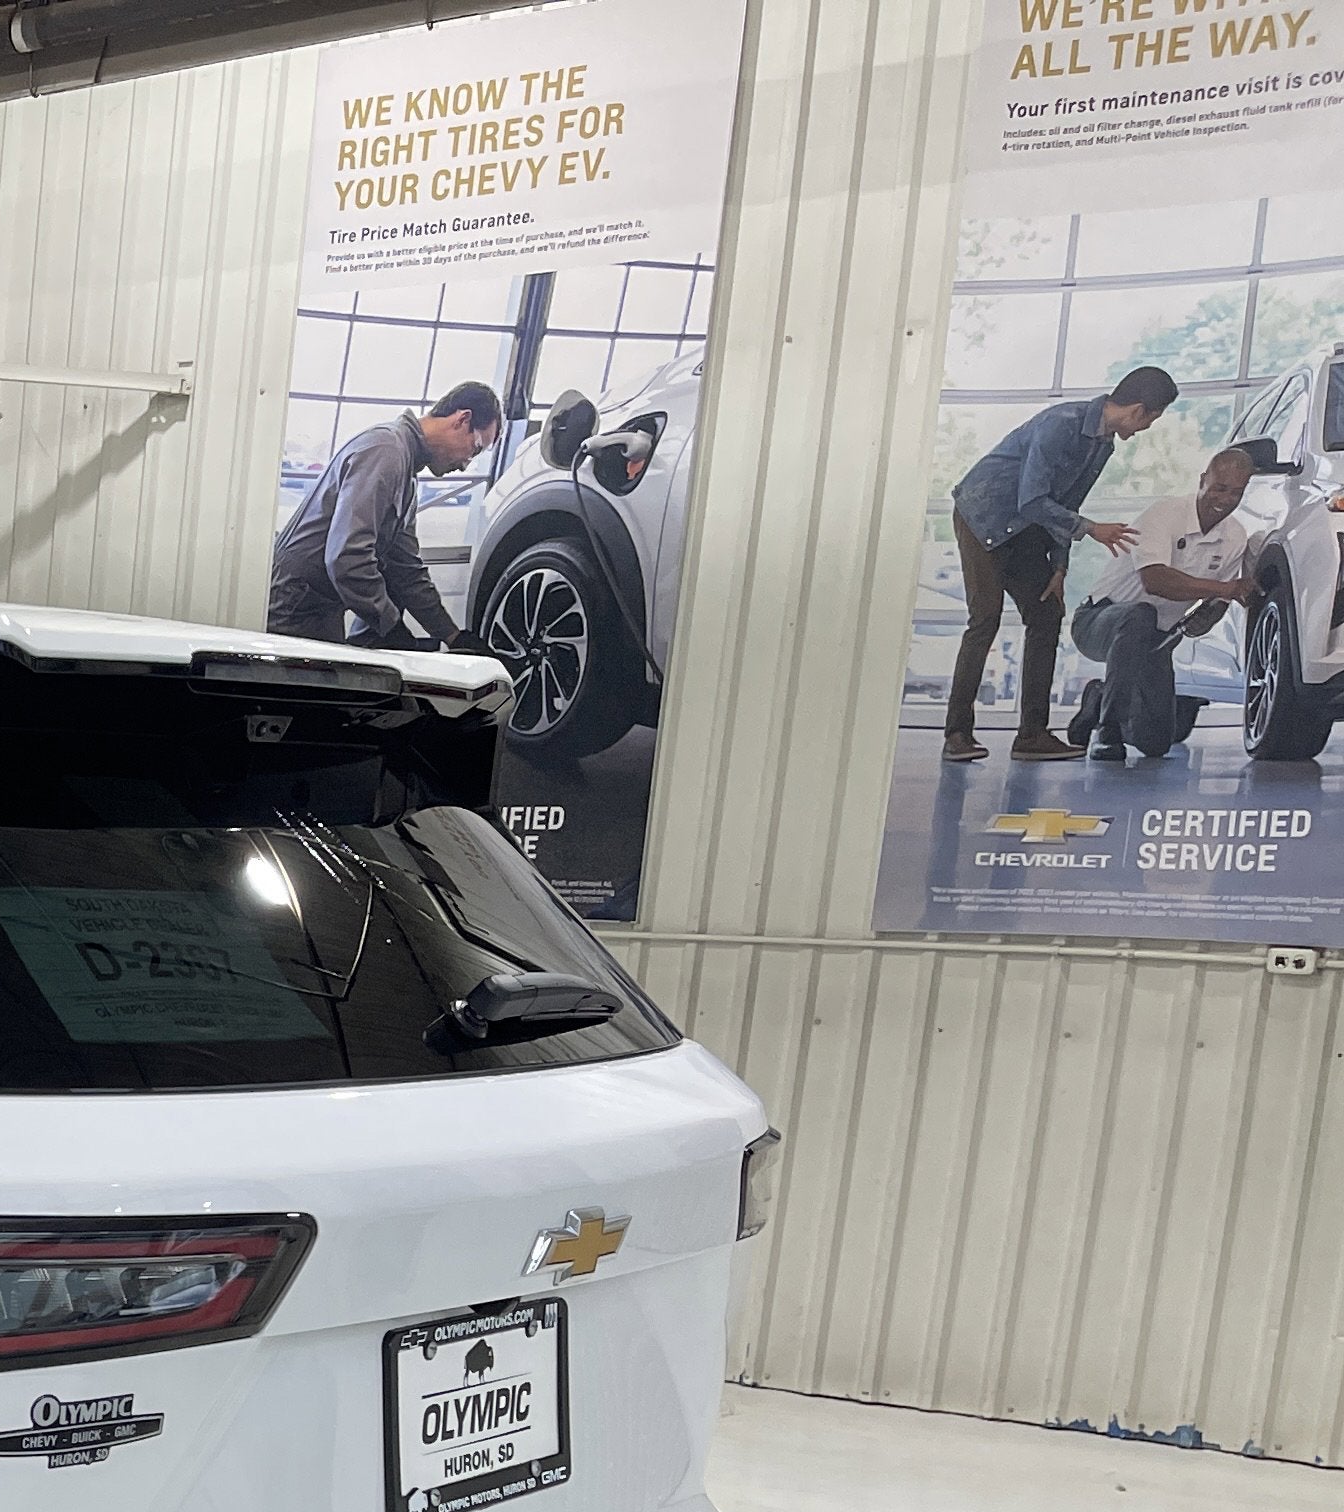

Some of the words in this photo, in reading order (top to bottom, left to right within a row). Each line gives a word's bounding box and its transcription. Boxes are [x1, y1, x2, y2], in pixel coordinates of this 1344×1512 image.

[1019, 0, 1153, 33] WERE
[1010, 39, 1091, 80] ALL
[1108, 25, 1194, 70] THE
[1210, 9, 1318, 58] WAY.
[343, 94, 395, 129] WE
[404, 77, 509, 122] KNOW
[520, 65, 587, 105] THE
[1007, 102, 1049, 119] Your
[1054, 96, 1096, 115] first
[1102, 84, 1230, 111] maintenance
[1236, 75, 1280, 96] visit
[1286, 72, 1302, 90] is
[1309, 69, 1344, 86] cov
[1003, 129, 1046, 139] Includes:
[1049, 126, 1060, 136] oil
[1063, 125, 1080, 134] and
[1083, 123, 1095, 133] oil
[1097, 120, 1122, 132] filter
[1124, 118, 1164, 130] change,
[1166, 113, 1197, 125] diesel
[1199, 109, 1240, 122] exhaust
[1242, 105, 1266, 116] fluid
[1269, 103, 1293, 114] tank
[1295, 98, 1321, 111] refill
[338, 130, 437, 171] RIGHT
[448, 114, 545, 157] TIRES
[556, 103, 624, 143] FOR
[1002, 142, 1029, 152] 4-tire
[1031, 138, 1073, 150] rotation,
[1075, 137, 1093, 147] and
[1095, 132, 1152, 145] Multi-Point
[1154, 127, 1190, 140] Vehicle
[1193, 122, 1250, 137] Inspection.
[335, 173, 419, 211] YOUR
[431, 155, 549, 201] CHEVY
[558, 147, 611, 185] EV.
[327, 253, 355, 262] Provide
[368, 250, 384, 259] with
[393, 247, 416, 257] better
[418, 243, 446, 255] eligible
[448, 242, 468, 252] price
[470, 240, 479, 248] at
[481, 238, 493, 247] the
[496, 236, 513, 246] time
[516, 233, 524, 243] of
[526, 230, 565, 244] purchase,
[568, 227, 583, 237] and
[607, 221, 633, 232] match
[329, 229, 356, 244] Tire
[361, 225, 398, 241] Price
[403, 219, 447, 237] Match
[452, 212, 535, 231] Guarantee.
[325, 265, 341, 274] Find
[350, 262, 373, 272] better
[375, 261, 394, 272] price
[397, 258, 420, 268] within
[422, 257, 432, 265] 30
[434, 254, 451, 266] days
[454, 253, 463, 262] of
[464, 251, 477, 260] the
[479, 248, 518, 262] purchase,
[520, 245, 534, 254] and
[557, 239, 585, 250] refund
[588, 237, 601, 246] the
[501, 806, 565, 830] IFIED
[1141, 809, 1312, 839] CERTIFIED
[975, 852, 1112, 869] CHEVROLET
[1137, 843, 1278, 872] SERVICE
[422, 1381, 531, 1445] OLYMPIC
[22, 1434, 58, 1449] CHEVY
[71, 1429, 102, 1444] BUICK
[114, 1424, 137, 1438] GMC
[50, 1451, 92, 1468] HURON,
[95, 1448, 109, 1461] SD
[444, 1447, 494, 1478] HURON,
[498, 1442, 515, 1462] SD
[541, 1466, 567, 1485] GMC
[470, 1488, 503, 1506] MOTORS,
[502, 1480, 526, 1496] HURON
